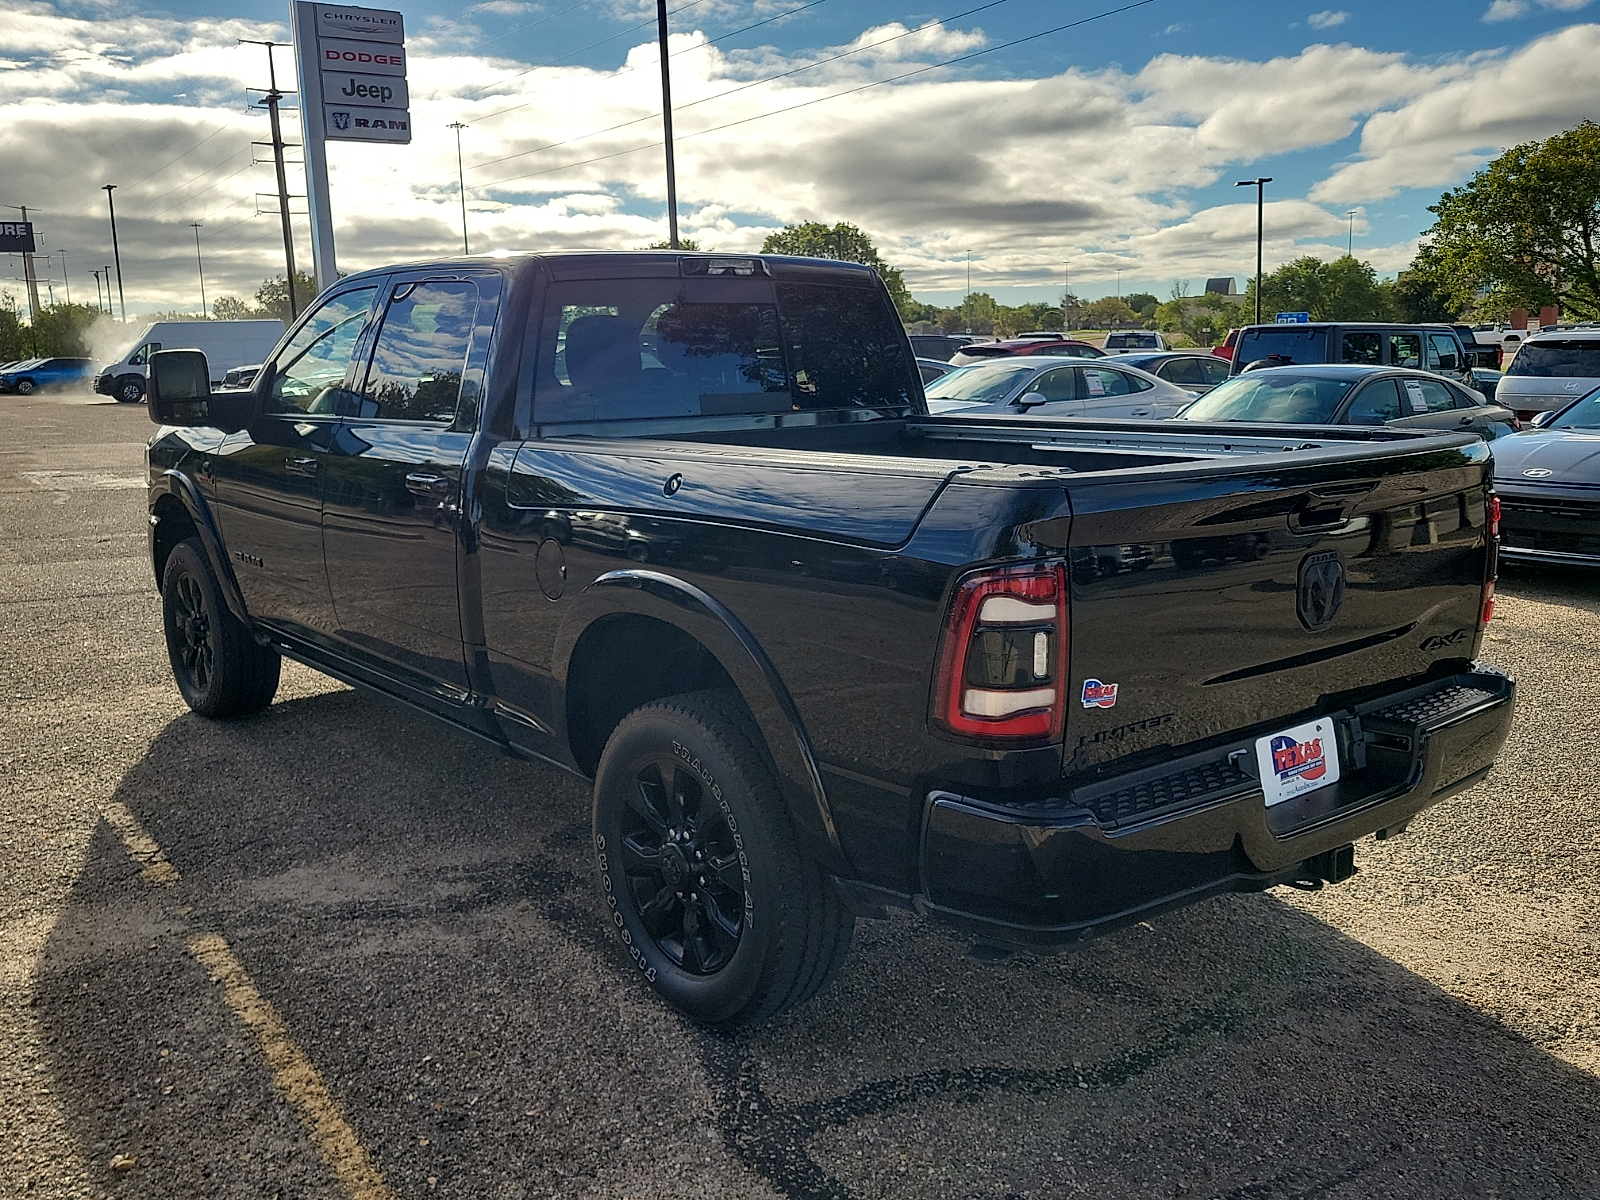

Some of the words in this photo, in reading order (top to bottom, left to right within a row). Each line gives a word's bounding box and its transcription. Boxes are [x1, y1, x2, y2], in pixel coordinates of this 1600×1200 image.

[324, 12, 397, 25] CHRYSLER
[325, 49, 402, 66] DODGE
[341, 78, 393, 103] Jeep
[354, 117, 407, 131] RAM
[1274, 738, 1322, 771] TEXAS
